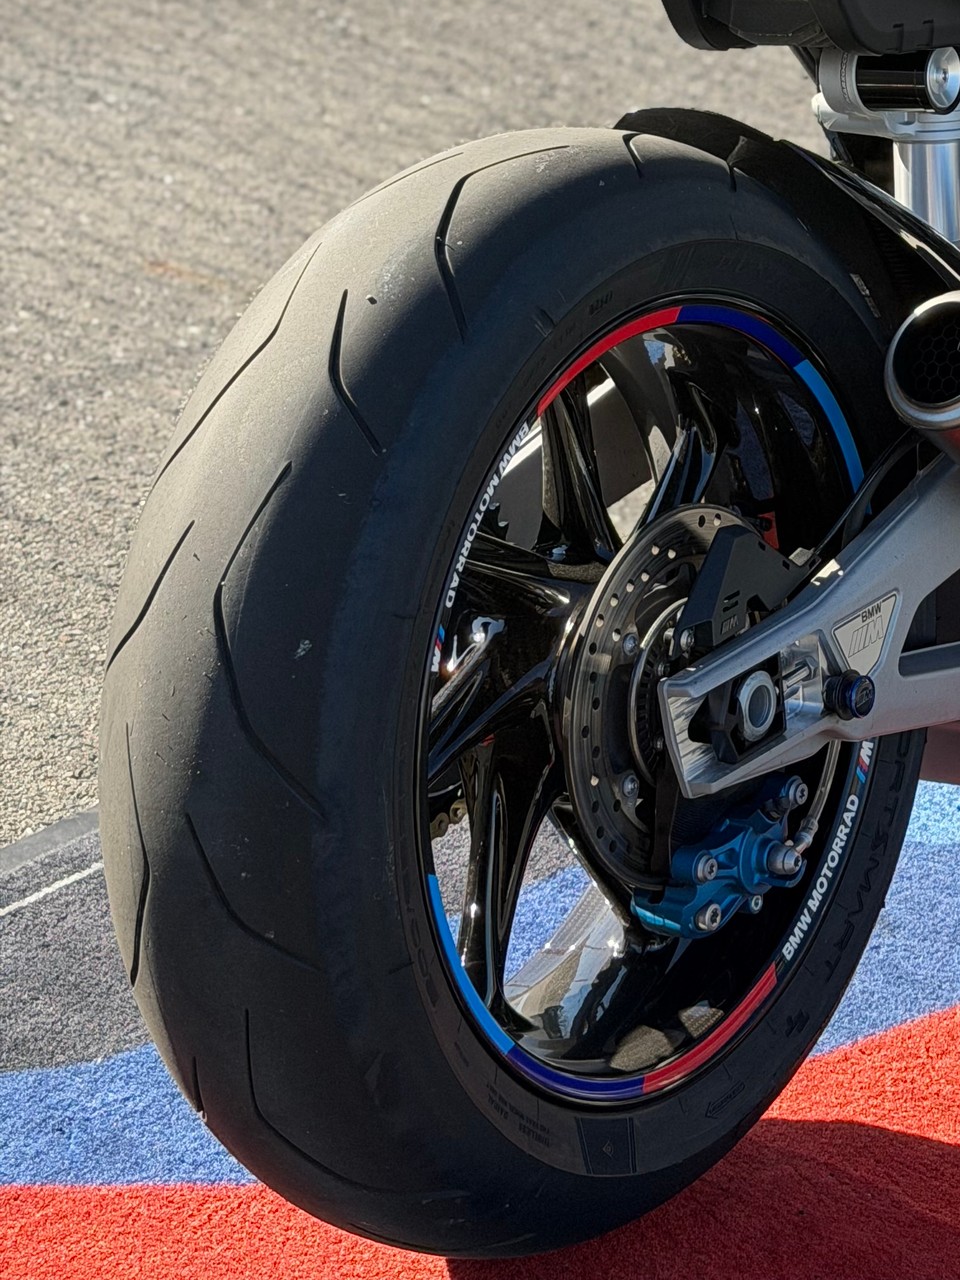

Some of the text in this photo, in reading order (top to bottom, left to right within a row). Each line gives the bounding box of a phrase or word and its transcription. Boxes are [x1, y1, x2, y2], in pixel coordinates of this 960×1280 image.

[500, 420, 530, 478] BMW
[445, 475, 500, 609] MOTORRAD
[861, 602, 882, 624] BMW
[781, 909, 812, 962] BMW
[809, 793, 860, 915] MOTORRAD
